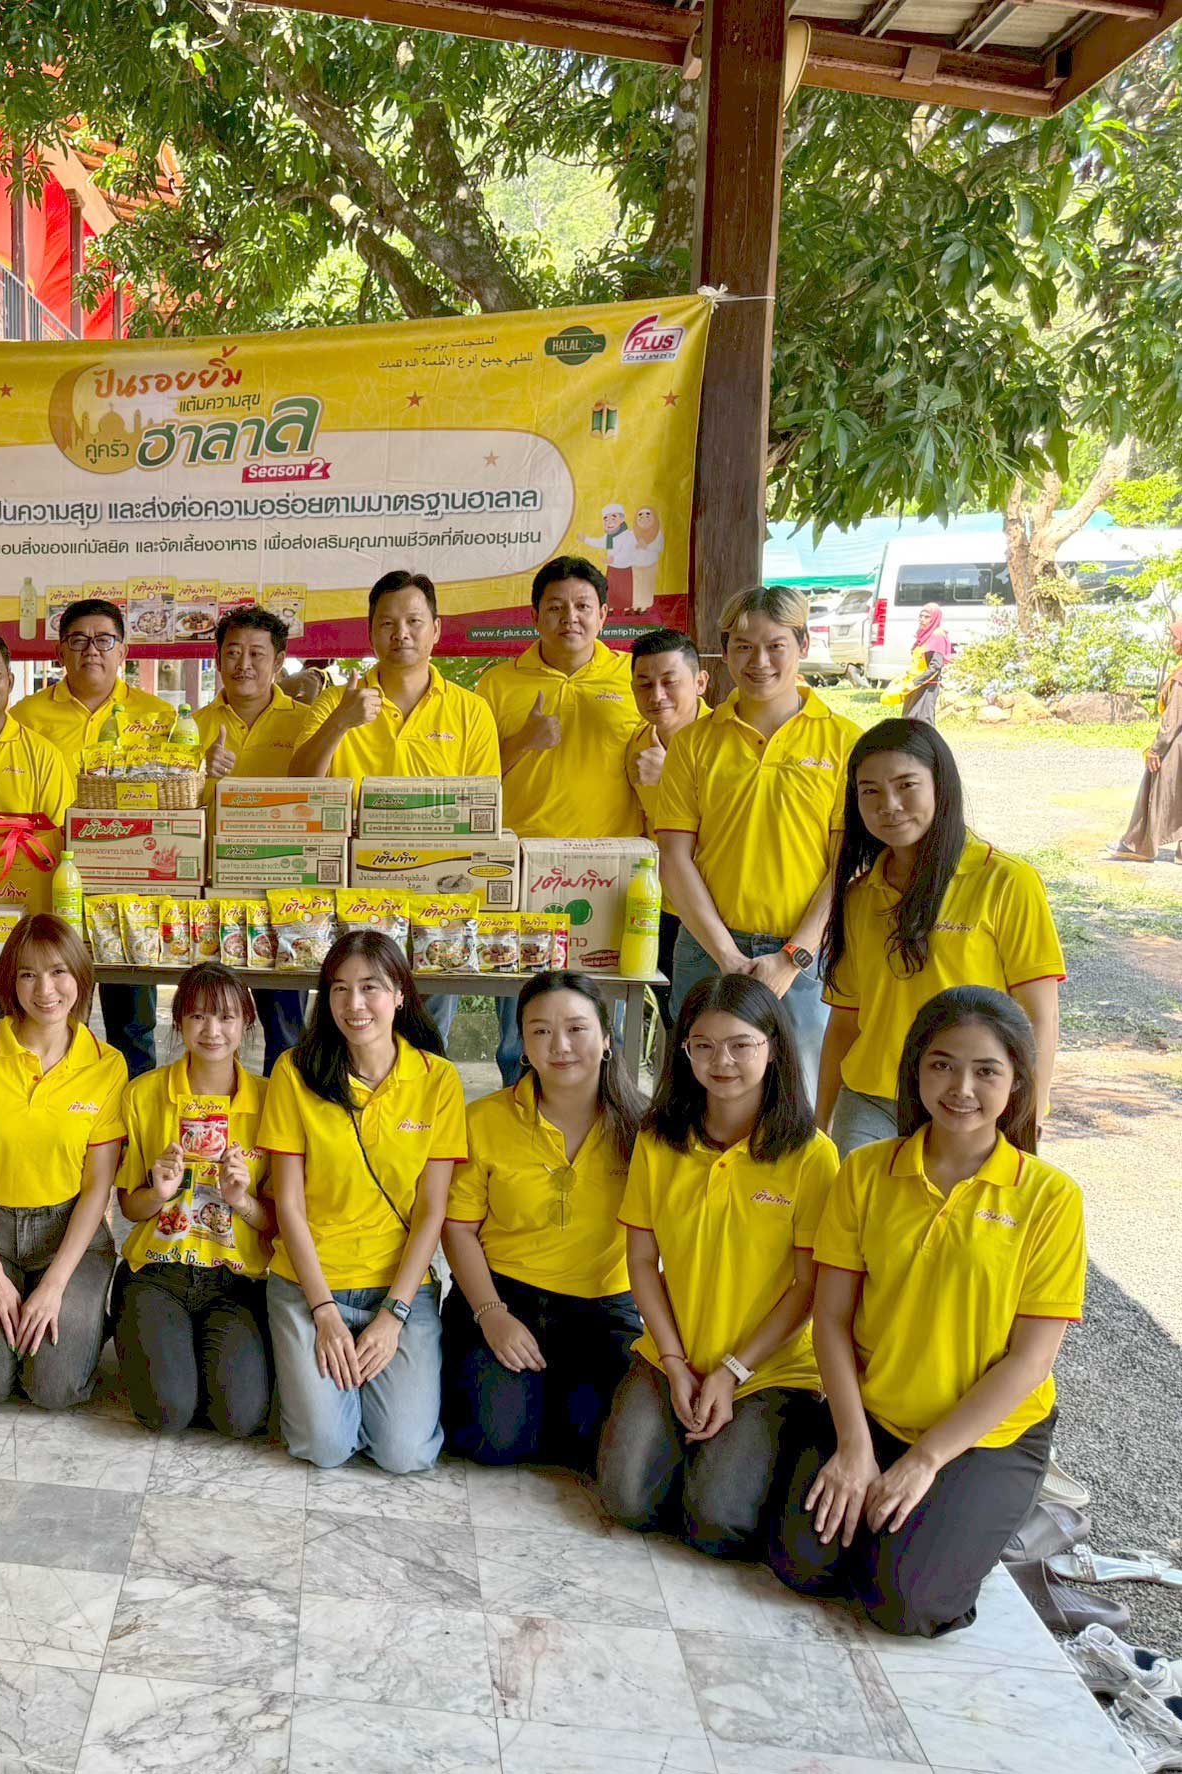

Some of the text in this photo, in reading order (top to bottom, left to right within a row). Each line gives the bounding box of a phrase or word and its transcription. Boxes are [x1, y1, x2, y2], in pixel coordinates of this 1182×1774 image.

[552, 339, 580, 351] HALAL
[93, 345, 243, 399] ปันรอยยิ้ม
[179, 391, 261, 413] แต้มความสุข
[85, 396, 321, 468] คู่ครัว ฮาลาล
[247, 458, 324, 479] Season 2
[108, 489, 538, 520] และส่งต่อความอร่อยตามมาตรฐานฮาลาล
[135, 533, 257, 553] และจัดเลี้ยงอาหาร
[264, 528, 542, 552] เพื่อส่งเสริมคุณภาพชีวิตที่ดีของชุมชน
[78, 819, 134, 839] เติมทิพ
[373, 850, 419, 866] เติมทิพ
[530, 867, 619, 896] เติมทิพ
[345, 897, 404, 915] เติมทิพ
[419, 902, 471, 919] เติมทิพ
